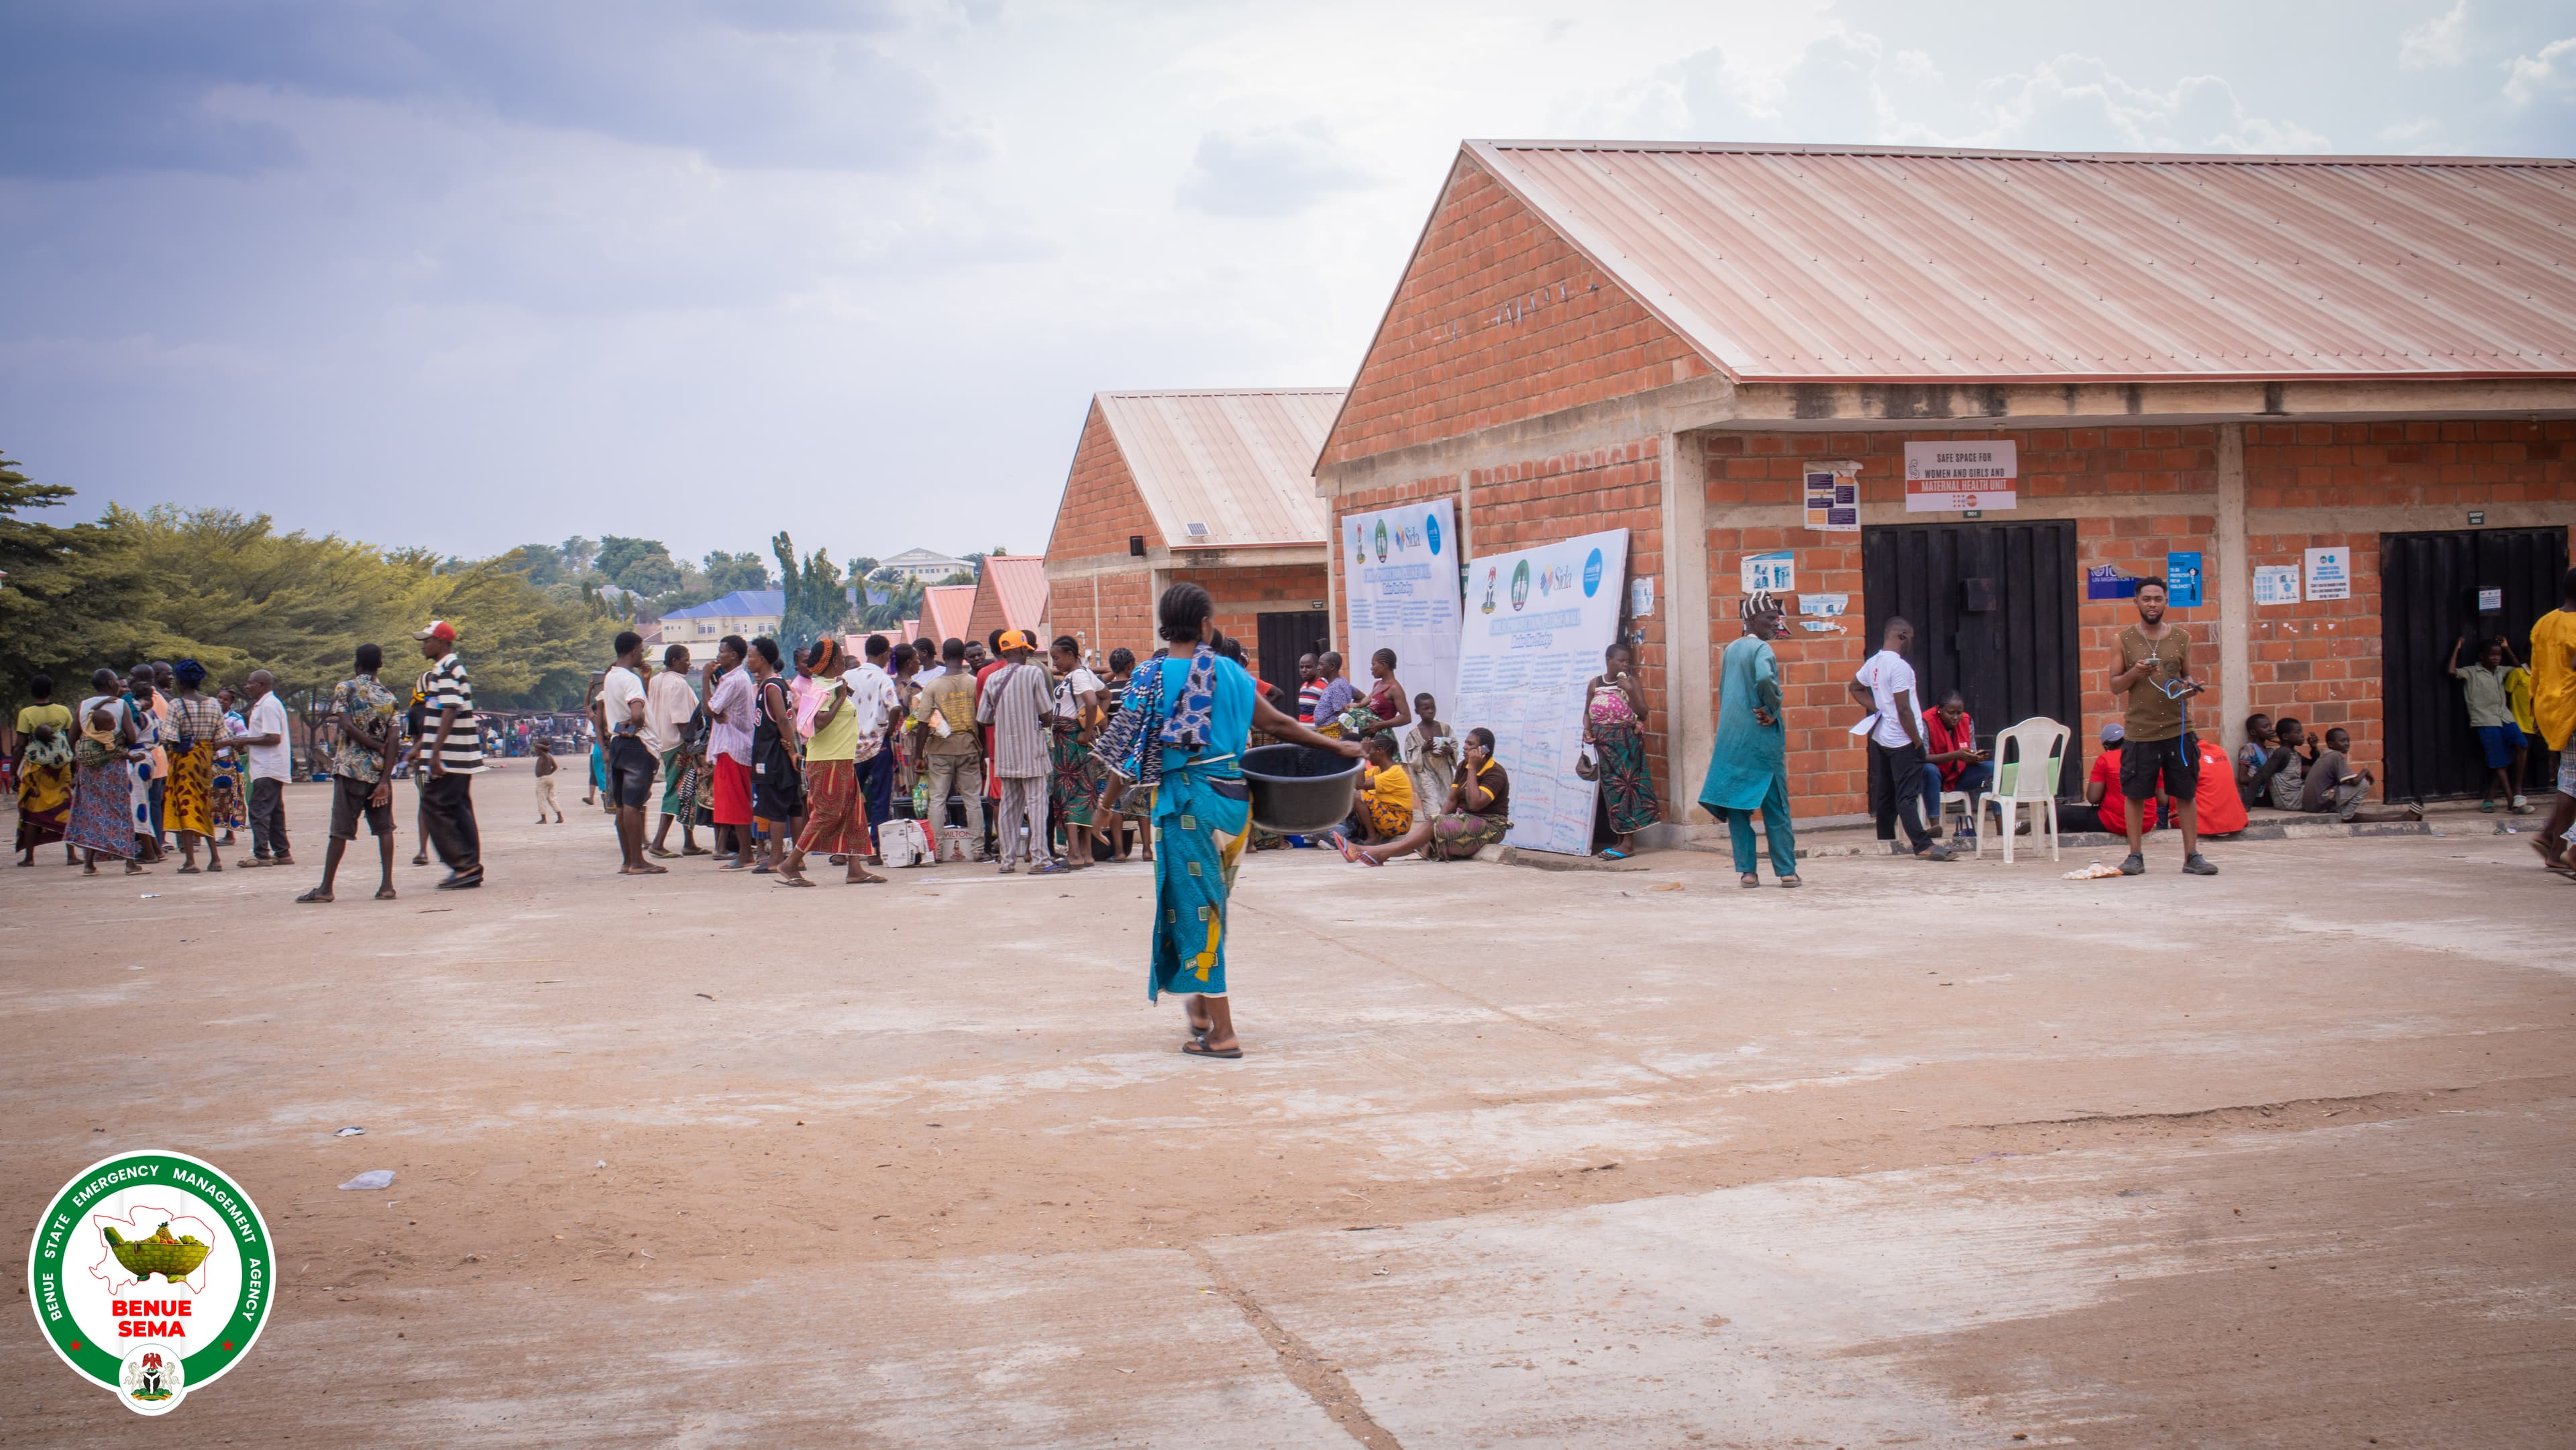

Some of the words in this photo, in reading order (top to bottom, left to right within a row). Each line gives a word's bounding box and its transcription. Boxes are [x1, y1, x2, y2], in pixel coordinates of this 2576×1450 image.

[1937, 454, 1953, 463] SAFE
[1955, 453, 1976, 462] SPACE
[1979, 453, 1992, 462] FOR
[1925, 469, 1951, 478] WOMEN
[1953, 469, 1967, 478] AND
[1969, 468, 1989, 478] GIRLS
[1990, 468, 2004, 477] AND
[1921, 480, 1960, 492] MATERNAL
[1962, 480, 1988, 491] HEALTH
[1990, 479, 2007, 490] UNIT
[1405, 526, 1421, 548] Sida
[1554, 565, 1572, 590] Sida
